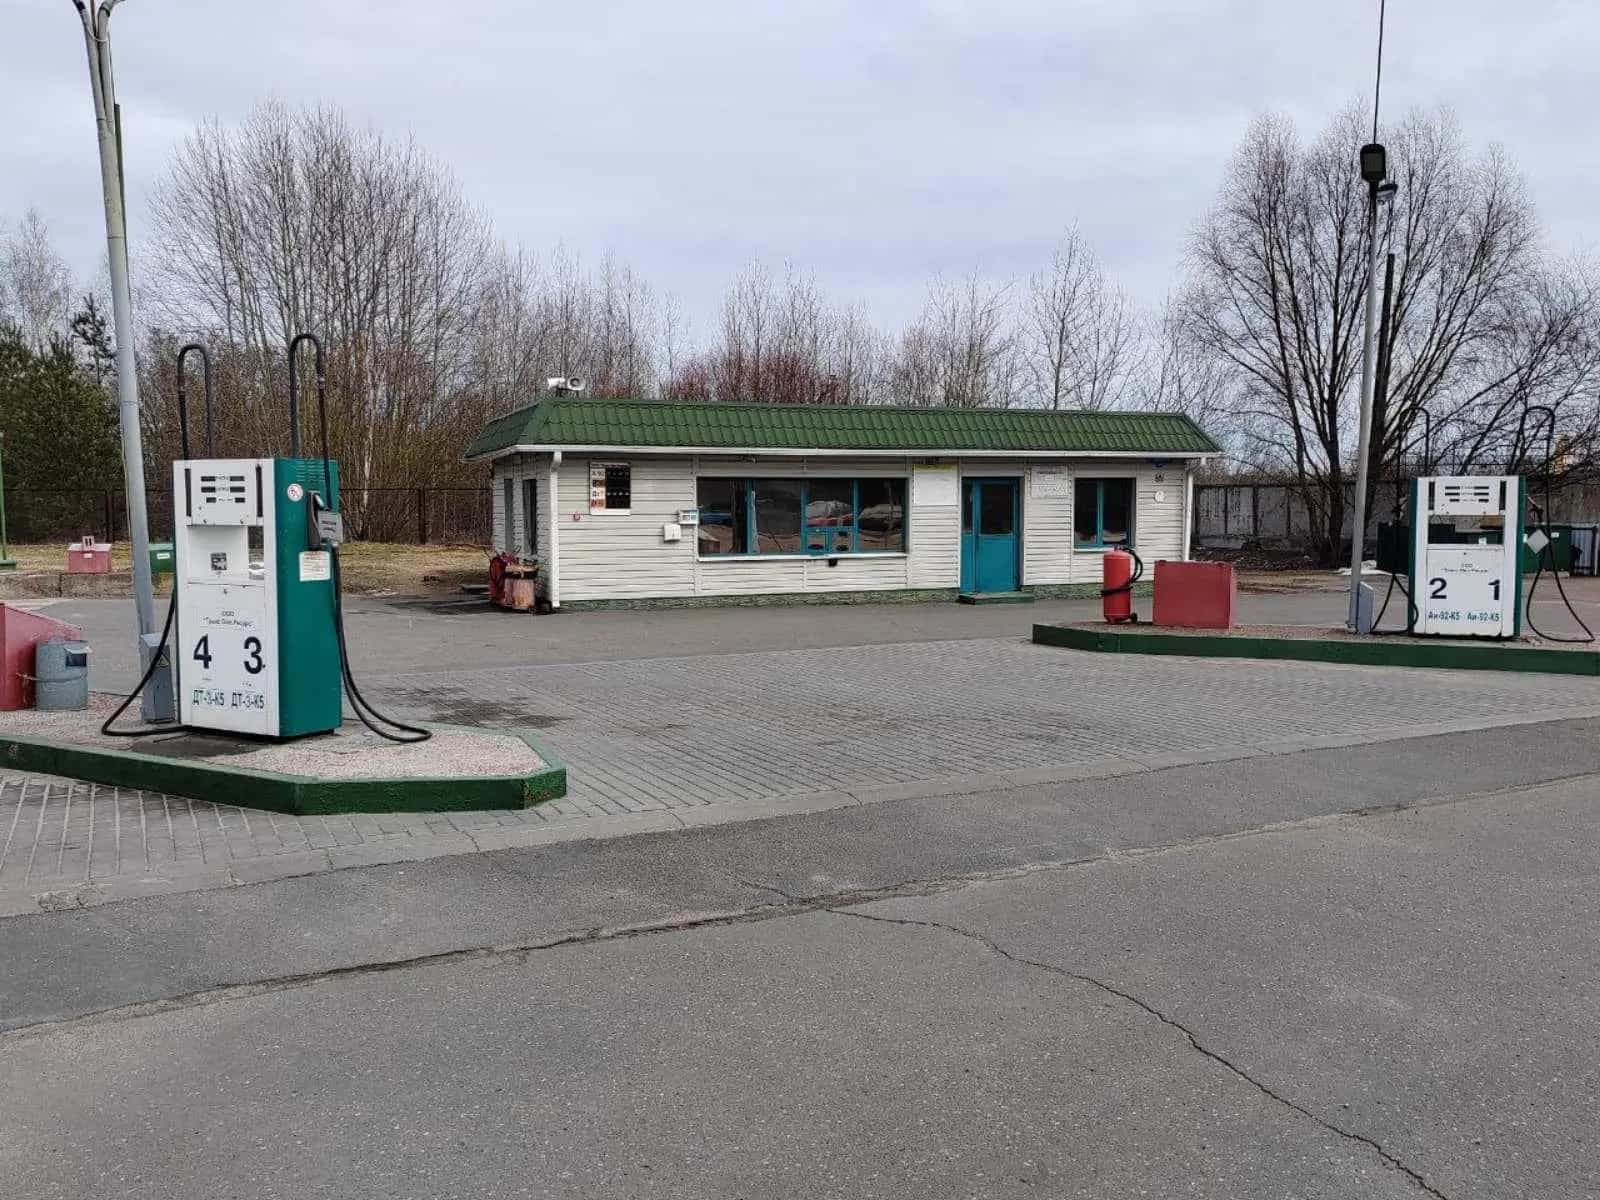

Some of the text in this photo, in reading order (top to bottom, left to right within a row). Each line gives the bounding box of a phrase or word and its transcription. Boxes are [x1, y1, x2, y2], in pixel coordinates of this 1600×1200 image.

[1429, 577, 1501, 601] 2 1
[193, 633, 263, 675] 4 3
